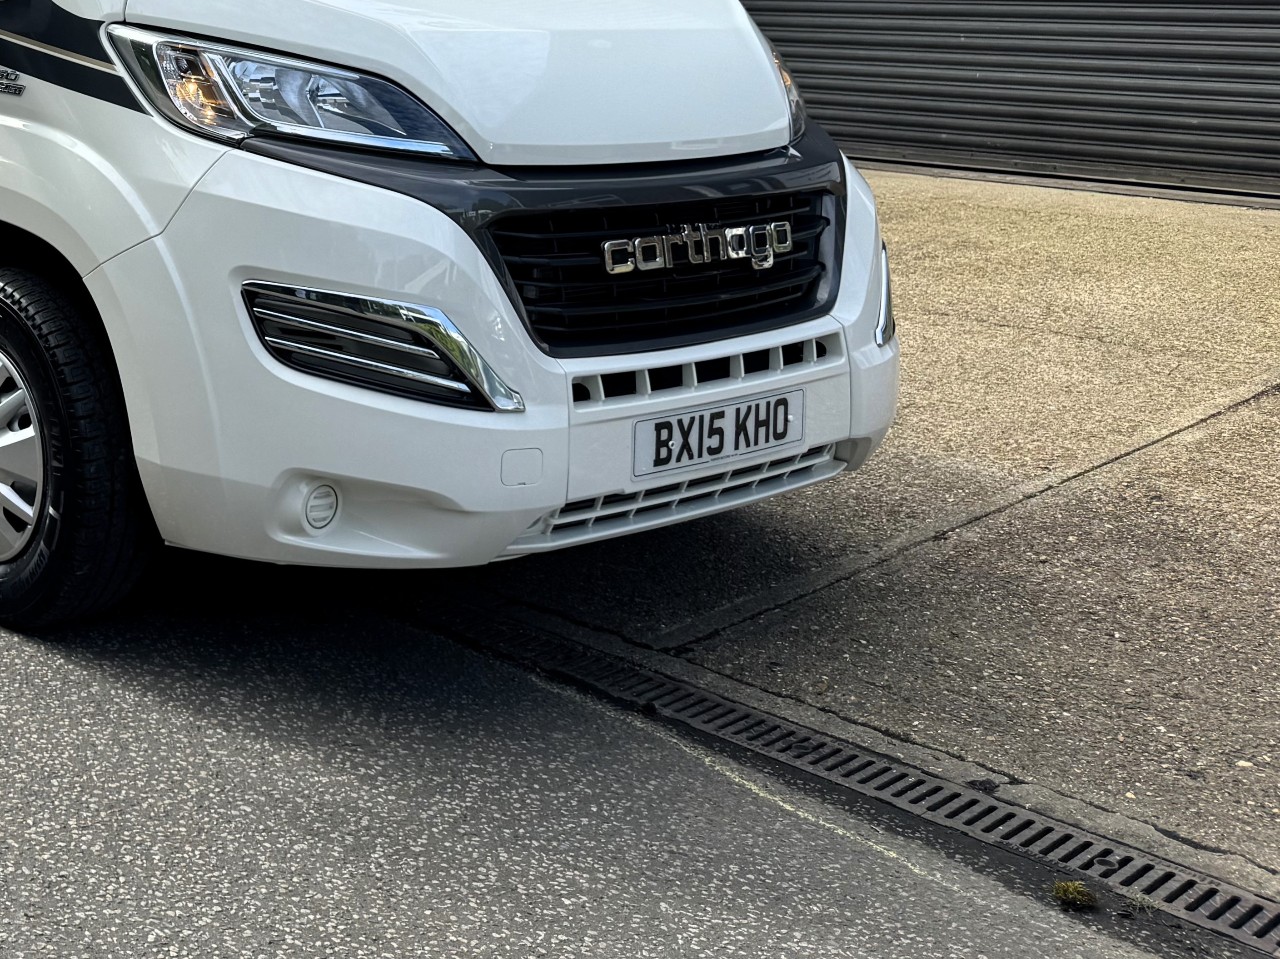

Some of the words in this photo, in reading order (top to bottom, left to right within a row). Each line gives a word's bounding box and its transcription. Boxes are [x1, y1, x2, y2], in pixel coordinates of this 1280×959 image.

[602, 221, 792, 275] carthago
[652, 410, 725, 468] BX15
[733, 396, 789, 451] KHO
